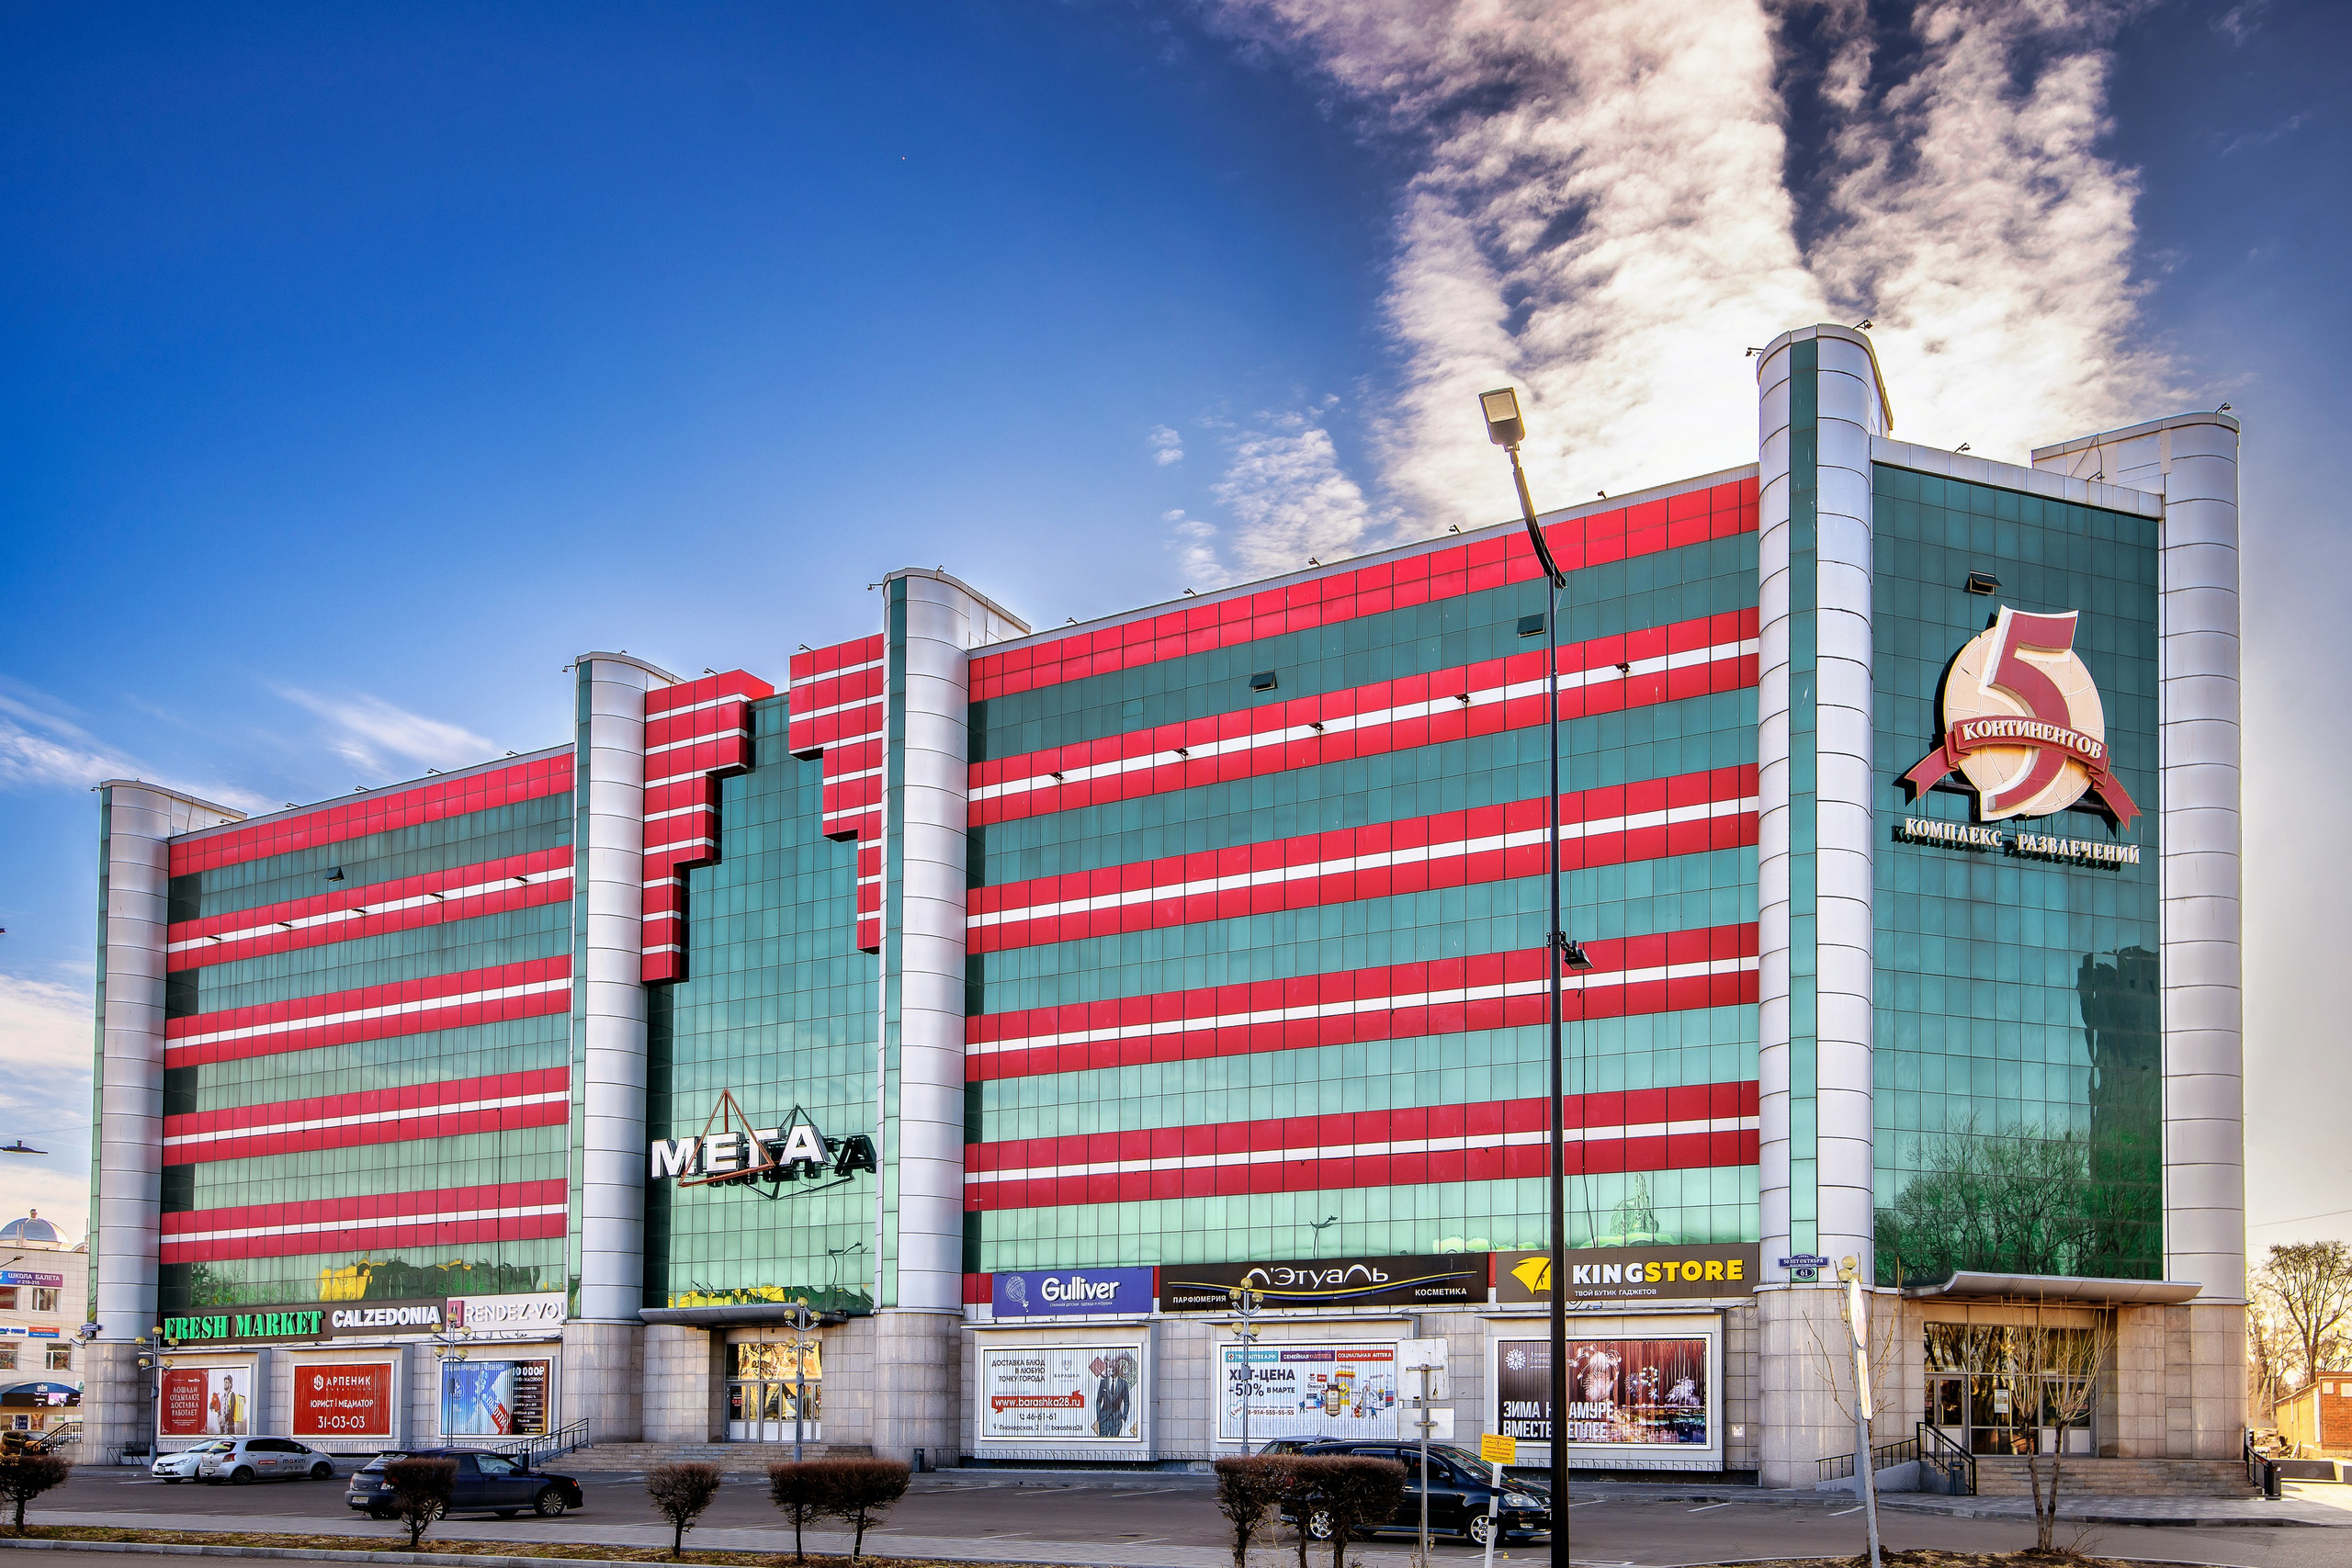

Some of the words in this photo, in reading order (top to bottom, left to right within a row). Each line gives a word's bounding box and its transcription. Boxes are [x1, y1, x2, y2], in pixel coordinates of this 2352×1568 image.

[1978, 604, 2079, 821] 5
[1961, 719, 2103, 760] КОНТИНЕНТОВ
[1905, 818, 2003, 847] КОМПЛЕКС
[2017, 833, 2141, 864] РАЗВЛЕЧЕНИЙ
[651, 1124, 826, 1179] МЕГА
[1041, 1277, 1121, 1302] Gulliver
[1415, 1288, 1467, 1296] КОСМЕТИКА
[1575, 1289, 1594, 1297] ТВОЙ
[1172, 1295, 1227, 1303] ПАРФЮМЕРИЯ
[164, 1314, 230, 1339] FRESH
[234, 1310, 323, 1337] MARKET
[332, 1305, 441, 1328] CALZEDONIA
[326, 1376, 371, 1386] АРПЕНИК
[1229, 1382, 1264, 1396] -50%
[311, 1399, 334, 1408] ЮРИСТ
[338, 1399, 374, 1408] МЕДИАТОР
[995, 1397, 1080, 1406] www.barashka28.ru
[1503, 1401, 1541, 1418] ЗИМА
[1568, 1402, 1615, 1419] АМУРЕ
[318, 1416, 366, 1428] 31-03-03
[1503, 1420, 1552, 1438] ВМЕСТЕ
[1567, 1422, 1608, 1439] ЕПЛЕЕ
